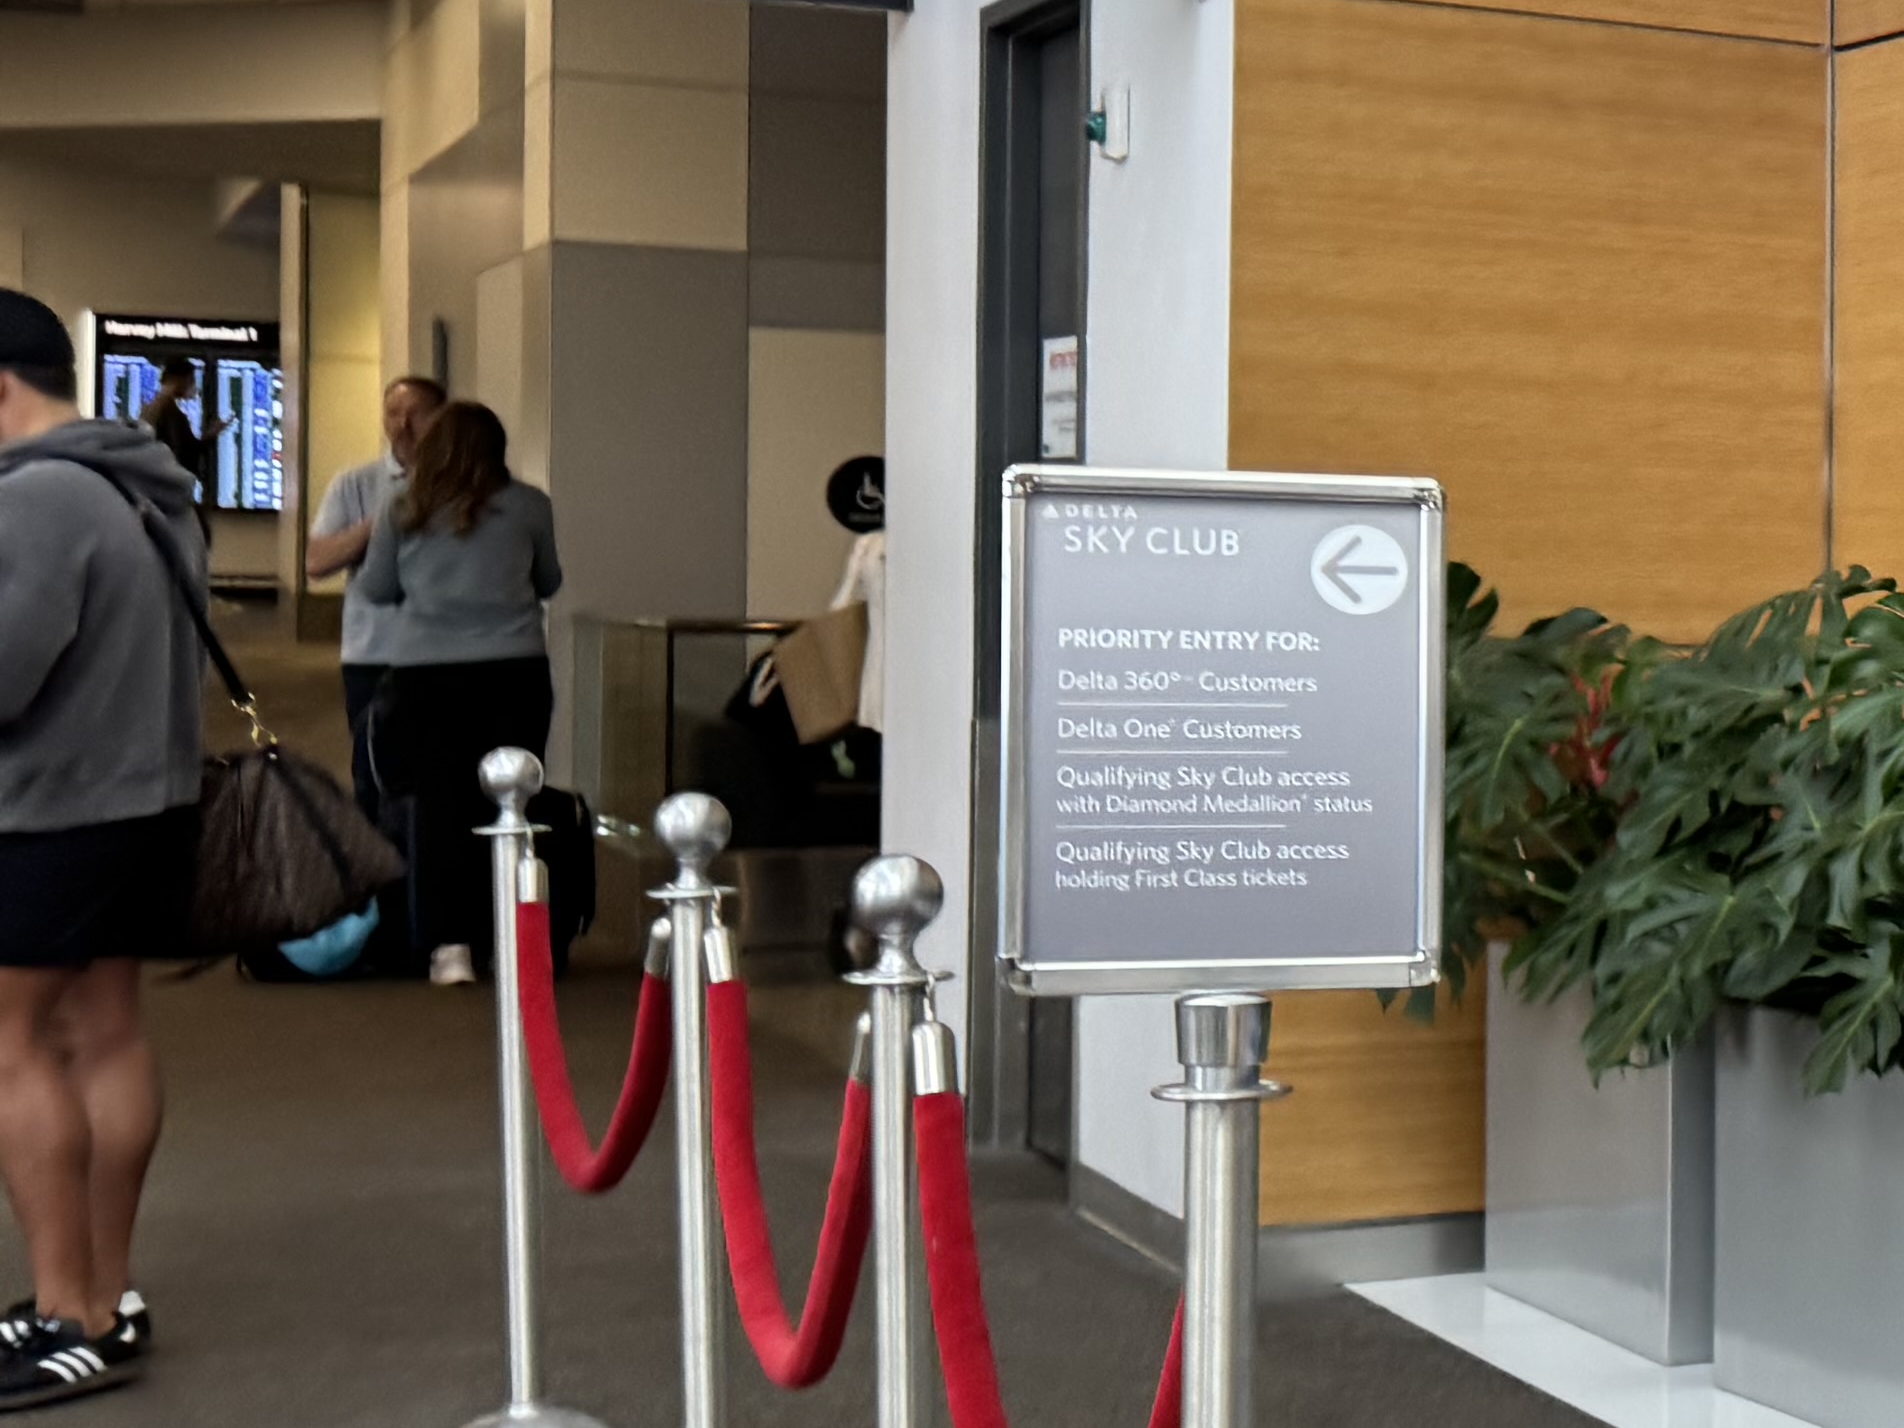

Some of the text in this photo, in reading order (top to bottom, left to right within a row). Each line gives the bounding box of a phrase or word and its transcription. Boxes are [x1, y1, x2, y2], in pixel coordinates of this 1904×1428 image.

[1064, 503, 1138, 520] DELTA
[1063, 525, 1241, 557] SKY CLUB
[1057, 627, 1320, 652] PRIORITY ENTRY FOR:
[1057, 670, 1118, 692] Delta
[1198, 672, 1318, 694] Customers
[1057, 717, 1118, 740] Delta
[1183, 719, 1303, 741] Customers
[1056, 766, 1352, 791] Qualifying Sky Club access
[1056, 793, 1100, 814] with
[1106, 795, 1198, 815] Diamond
[1313, 796, 1374, 814] status
[1056, 840, 1350, 866] Qualifying Sky Club access
[1055, 869, 1308, 892] holding First Class tickets
